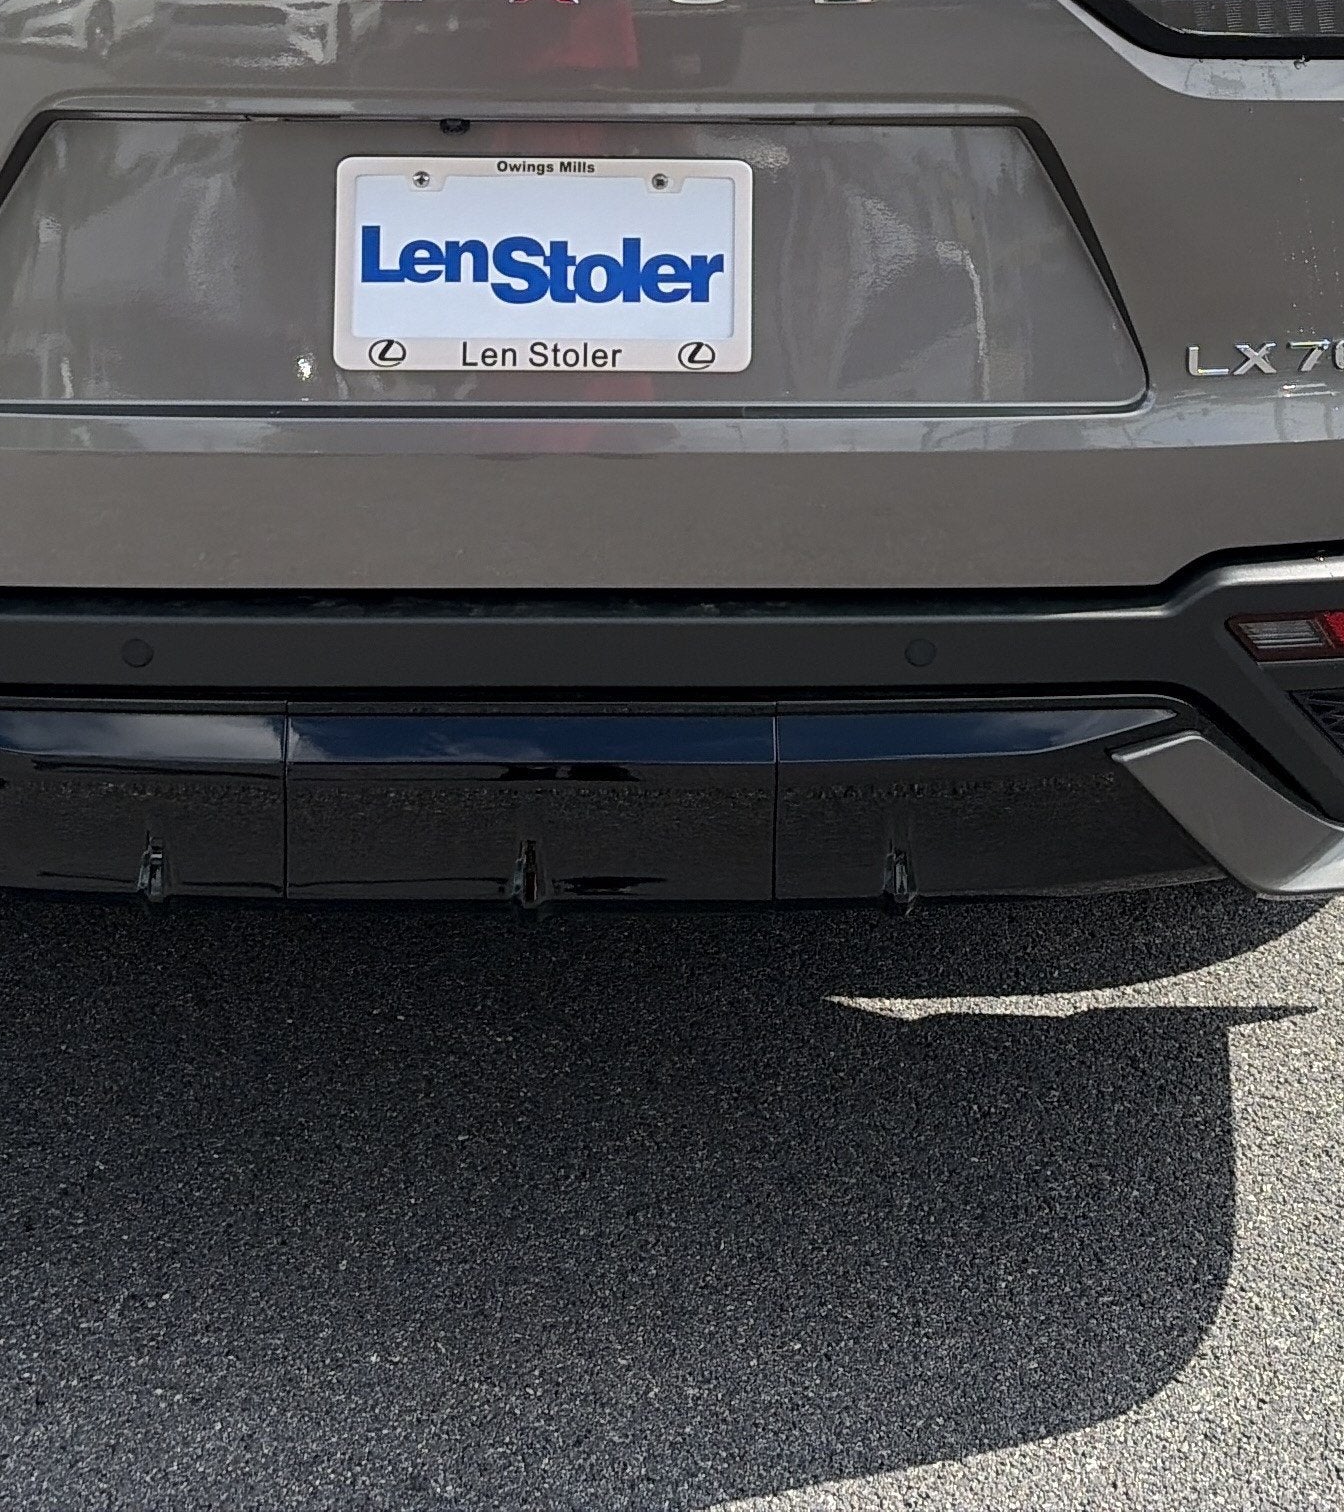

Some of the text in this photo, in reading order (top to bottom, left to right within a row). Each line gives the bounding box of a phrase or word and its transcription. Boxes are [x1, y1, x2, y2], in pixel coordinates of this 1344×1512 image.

[497, 160, 595, 176] Owings Mills
[462, 341, 623, 368] Len Stoler
